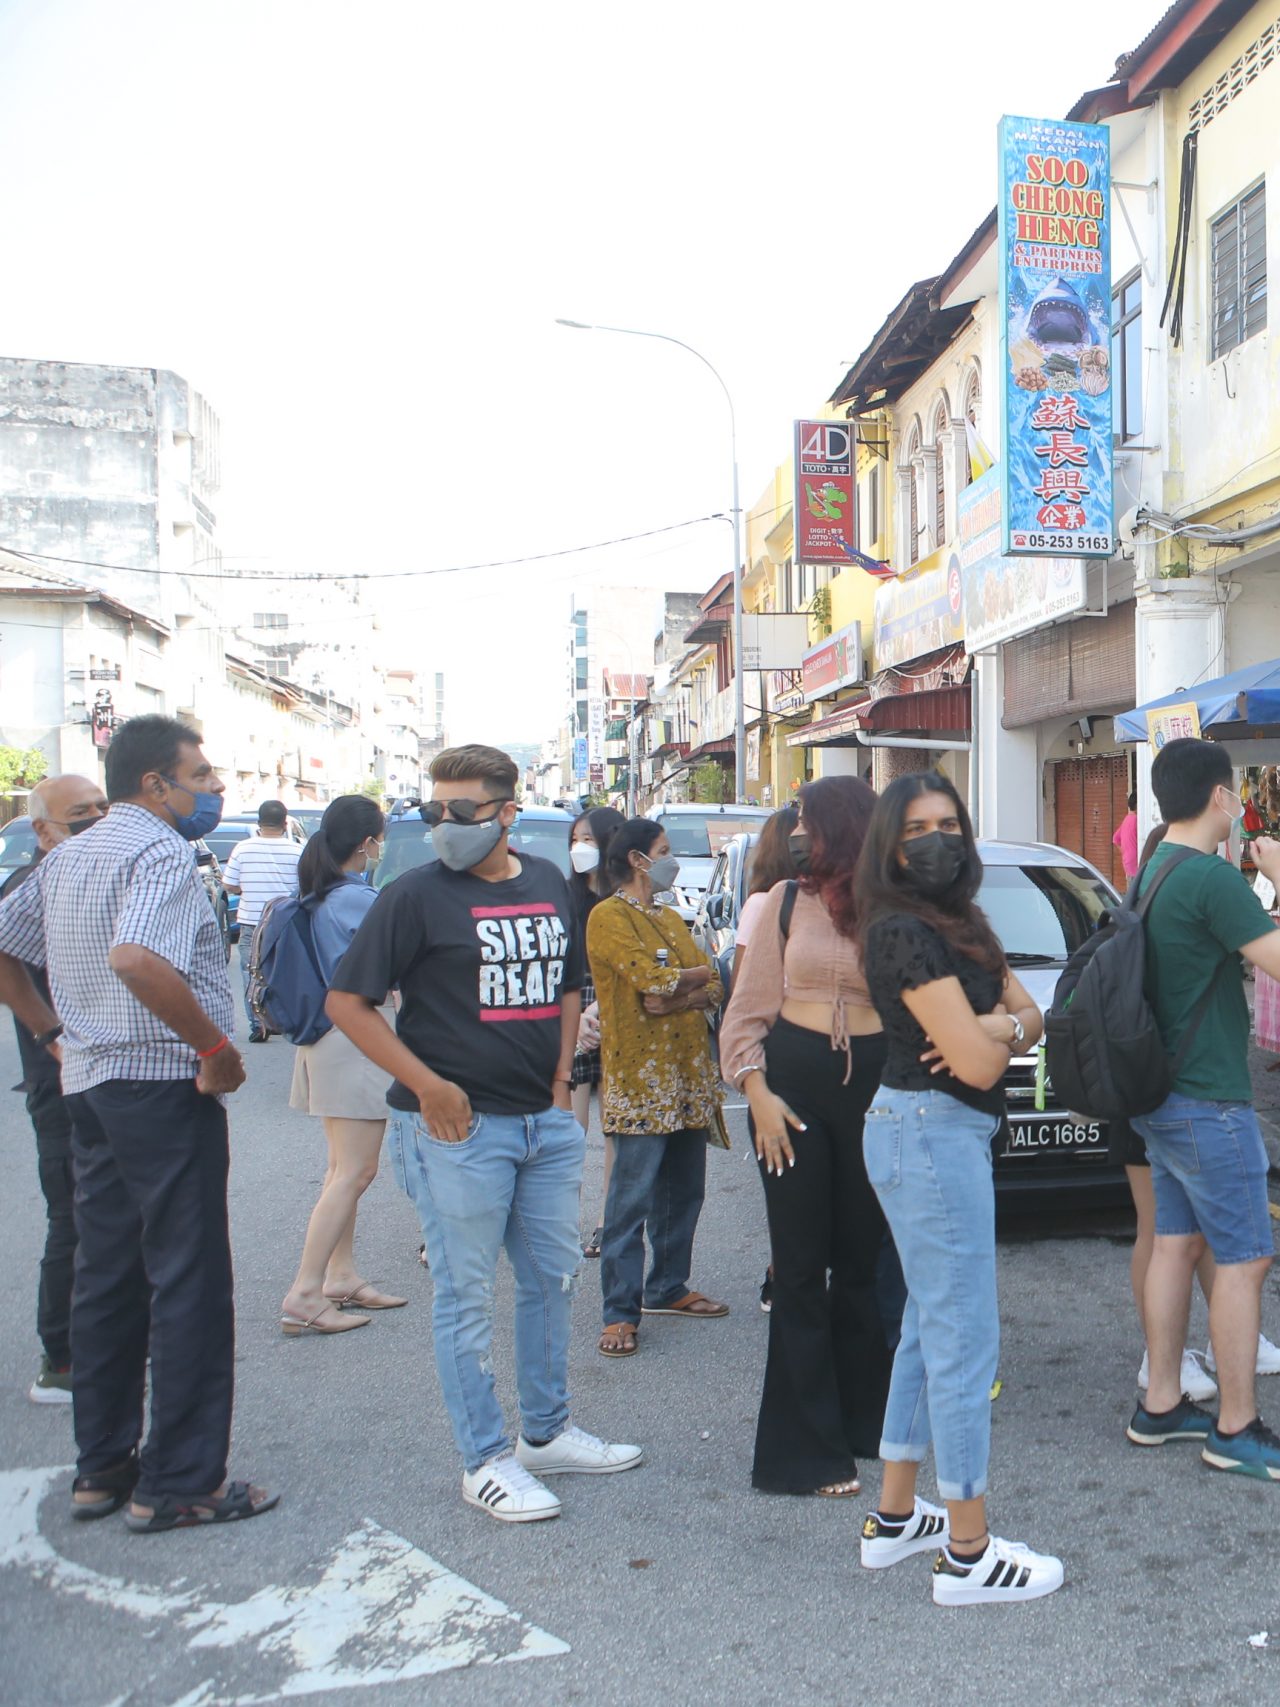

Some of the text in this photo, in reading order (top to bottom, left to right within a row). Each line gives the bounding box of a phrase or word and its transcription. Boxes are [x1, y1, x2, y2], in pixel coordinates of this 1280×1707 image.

[1014, 132, 1103, 149] MAKANAN
[1031, 126, 1084, 138] KEDAI
[1035, 143, 1080, 155] LAUT
[1025, 153, 1089, 187] SOO
[1012, 183, 1103, 219] CHEONG
[1016, 213, 1099, 248] HENG
[1014, 255, 1102, 274] ENTERPRISE
[1015, 243, 1102, 263] & PARTNERS
[802, 426, 850, 460] 4D
[1031, 394, 1091, 504] 蘇長興
[1041, 505, 1081, 529] 企業
[1029, 534, 1109, 550] 05-253 5163
[476, 916, 568, 963] SIEM
[479, 960, 563, 1007] REAP
[1054, 1123, 1100, 1145] 1665
